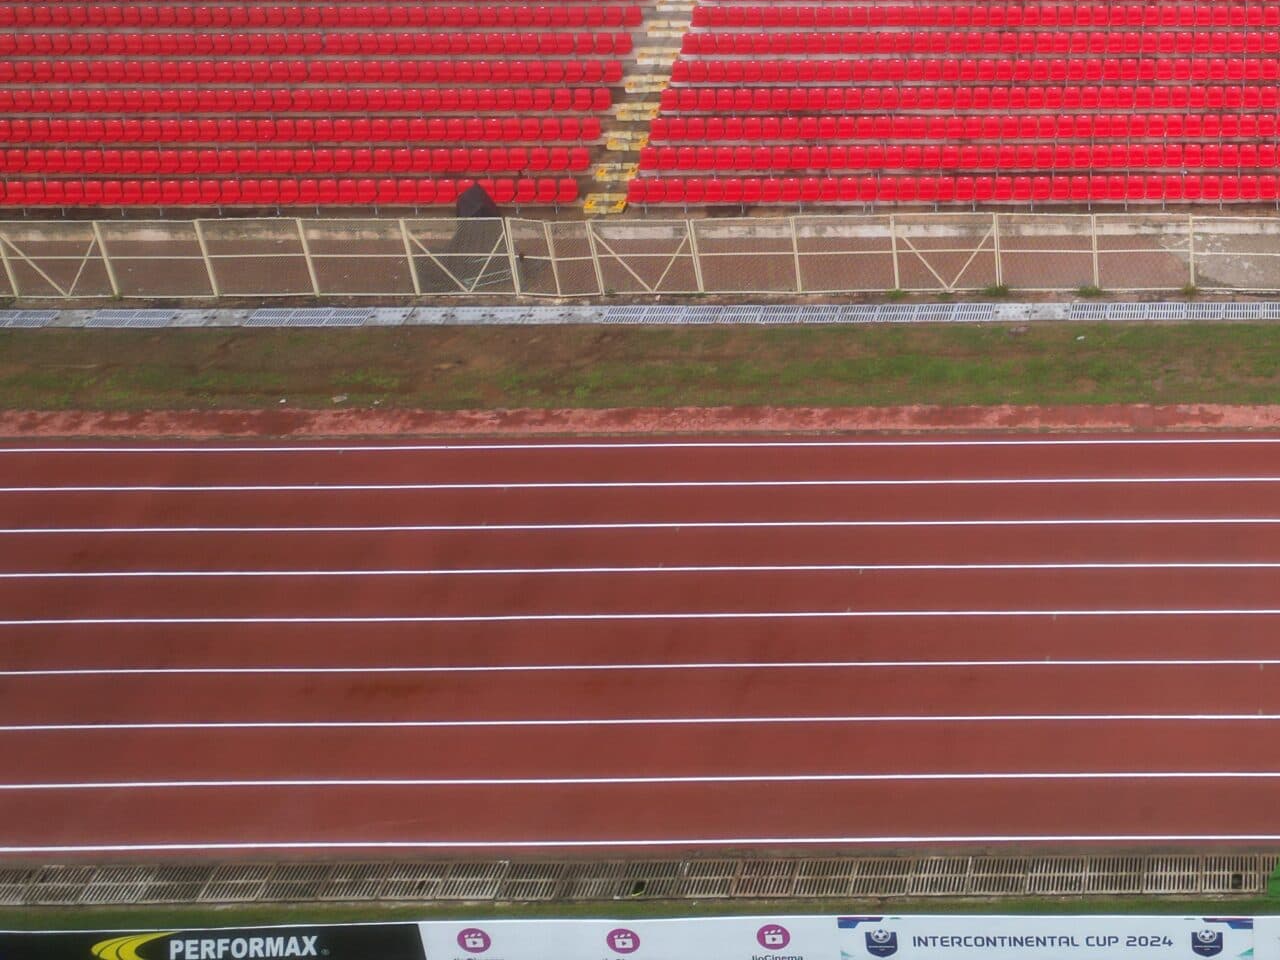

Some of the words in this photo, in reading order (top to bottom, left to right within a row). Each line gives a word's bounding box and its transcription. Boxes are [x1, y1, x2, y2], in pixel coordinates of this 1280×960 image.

[169, 935, 319, 960] PERFORMAX
[912, 935, 1080, 947] INTERCONTINENTAL
[1086, 935, 1119, 947] CUP
[1126, 935, 1174, 947] 2024
